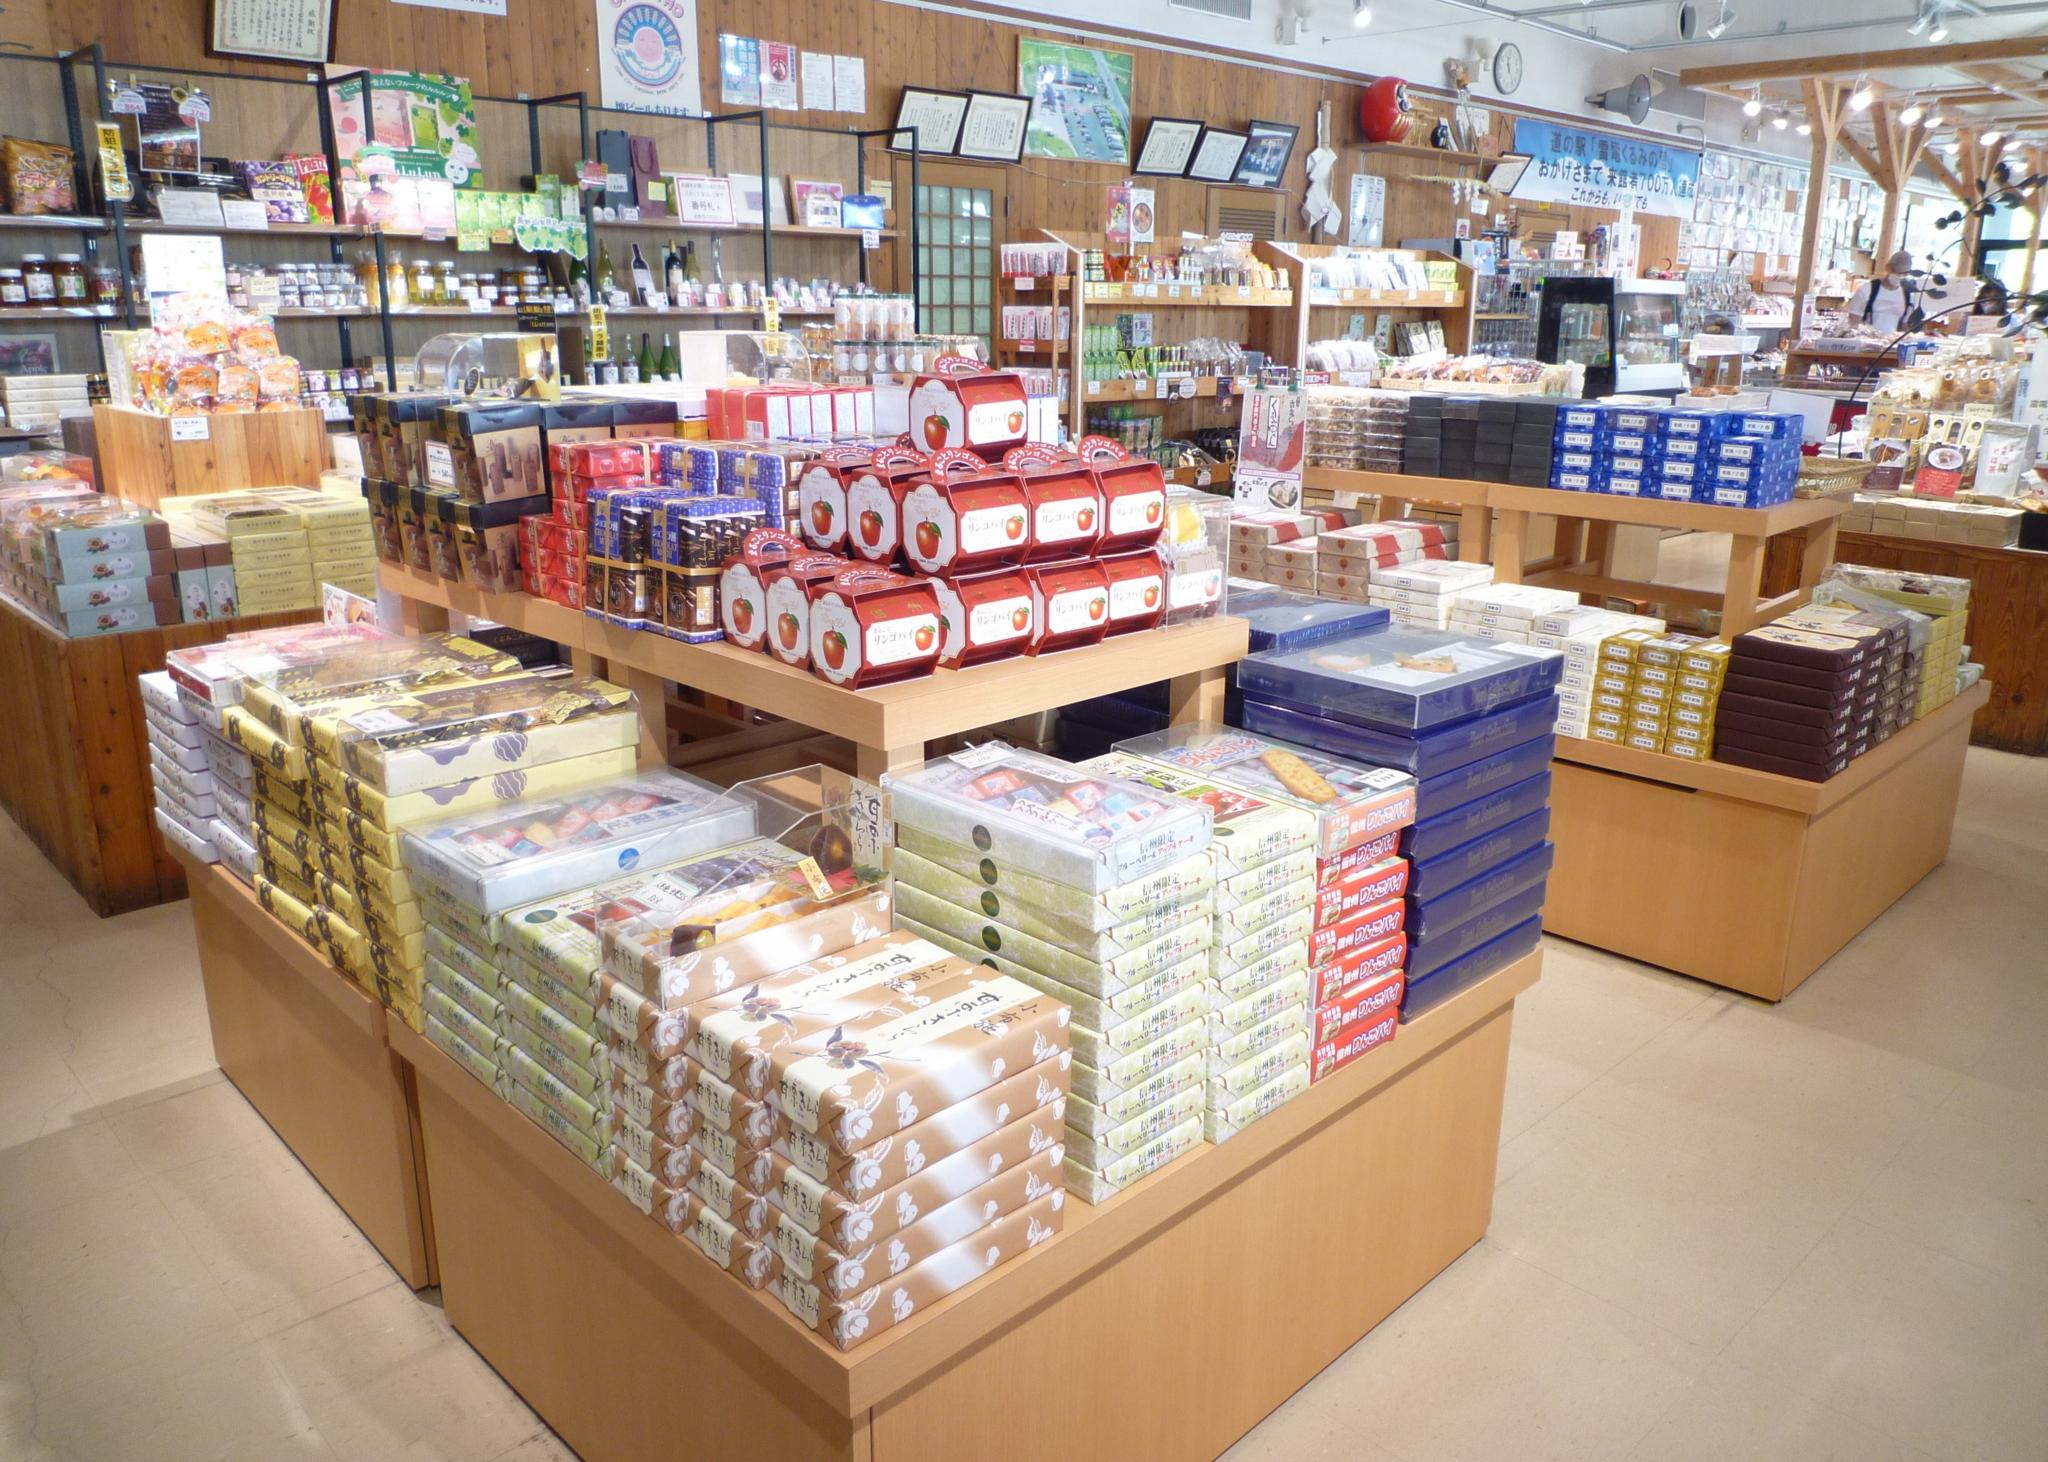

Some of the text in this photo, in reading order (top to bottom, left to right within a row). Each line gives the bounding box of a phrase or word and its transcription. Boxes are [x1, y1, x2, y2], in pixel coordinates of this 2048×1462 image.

[1538, 161, 1602, 183] おかげさまで
[1571, 187, 1648, 210] これからも、いでも
[935, 449, 987, 476] まるごとリンゴパイ
[749, 530, 801, 557] まるごとリンゴパイ
[874, 629, 914, 646] リンゴパイ
[1140, 830, 1175, 855] 信州限定
[1259, 828, 1290, 849] 信州限定
[1258, 861, 1289, 882] 信州限定
[1142, 873, 1180, 896] 信州限定
[1146, 901, 1180, 926] 信州限定
[1260, 892, 1290, 914] 信州限定
[1258, 923, 1287, 945] 信州限定
[1148, 936, 1181, 961] 信州限定
[1250, 956, 1280, 979] 信州限定
[1145, 967, 1178, 994] 信州限定
[1252, 989, 1282, 1013] 信州限定
[1142, 1005, 1176, 1032] 信州限定
[1249, 1020, 1280, 1045] 信州限定
[1142, 1039, 1176, 1066] 信州限定
[1255, 1051, 1283, 1077] 信州限定
[1140, 1072, 1174, 1100] 信州限定
[1255, 1083, 1285, 1109] 信州限定
[1141, 1104, 1174, 1132] 信州限定
[1138, 1137, 1171, 1165] 信州限定
